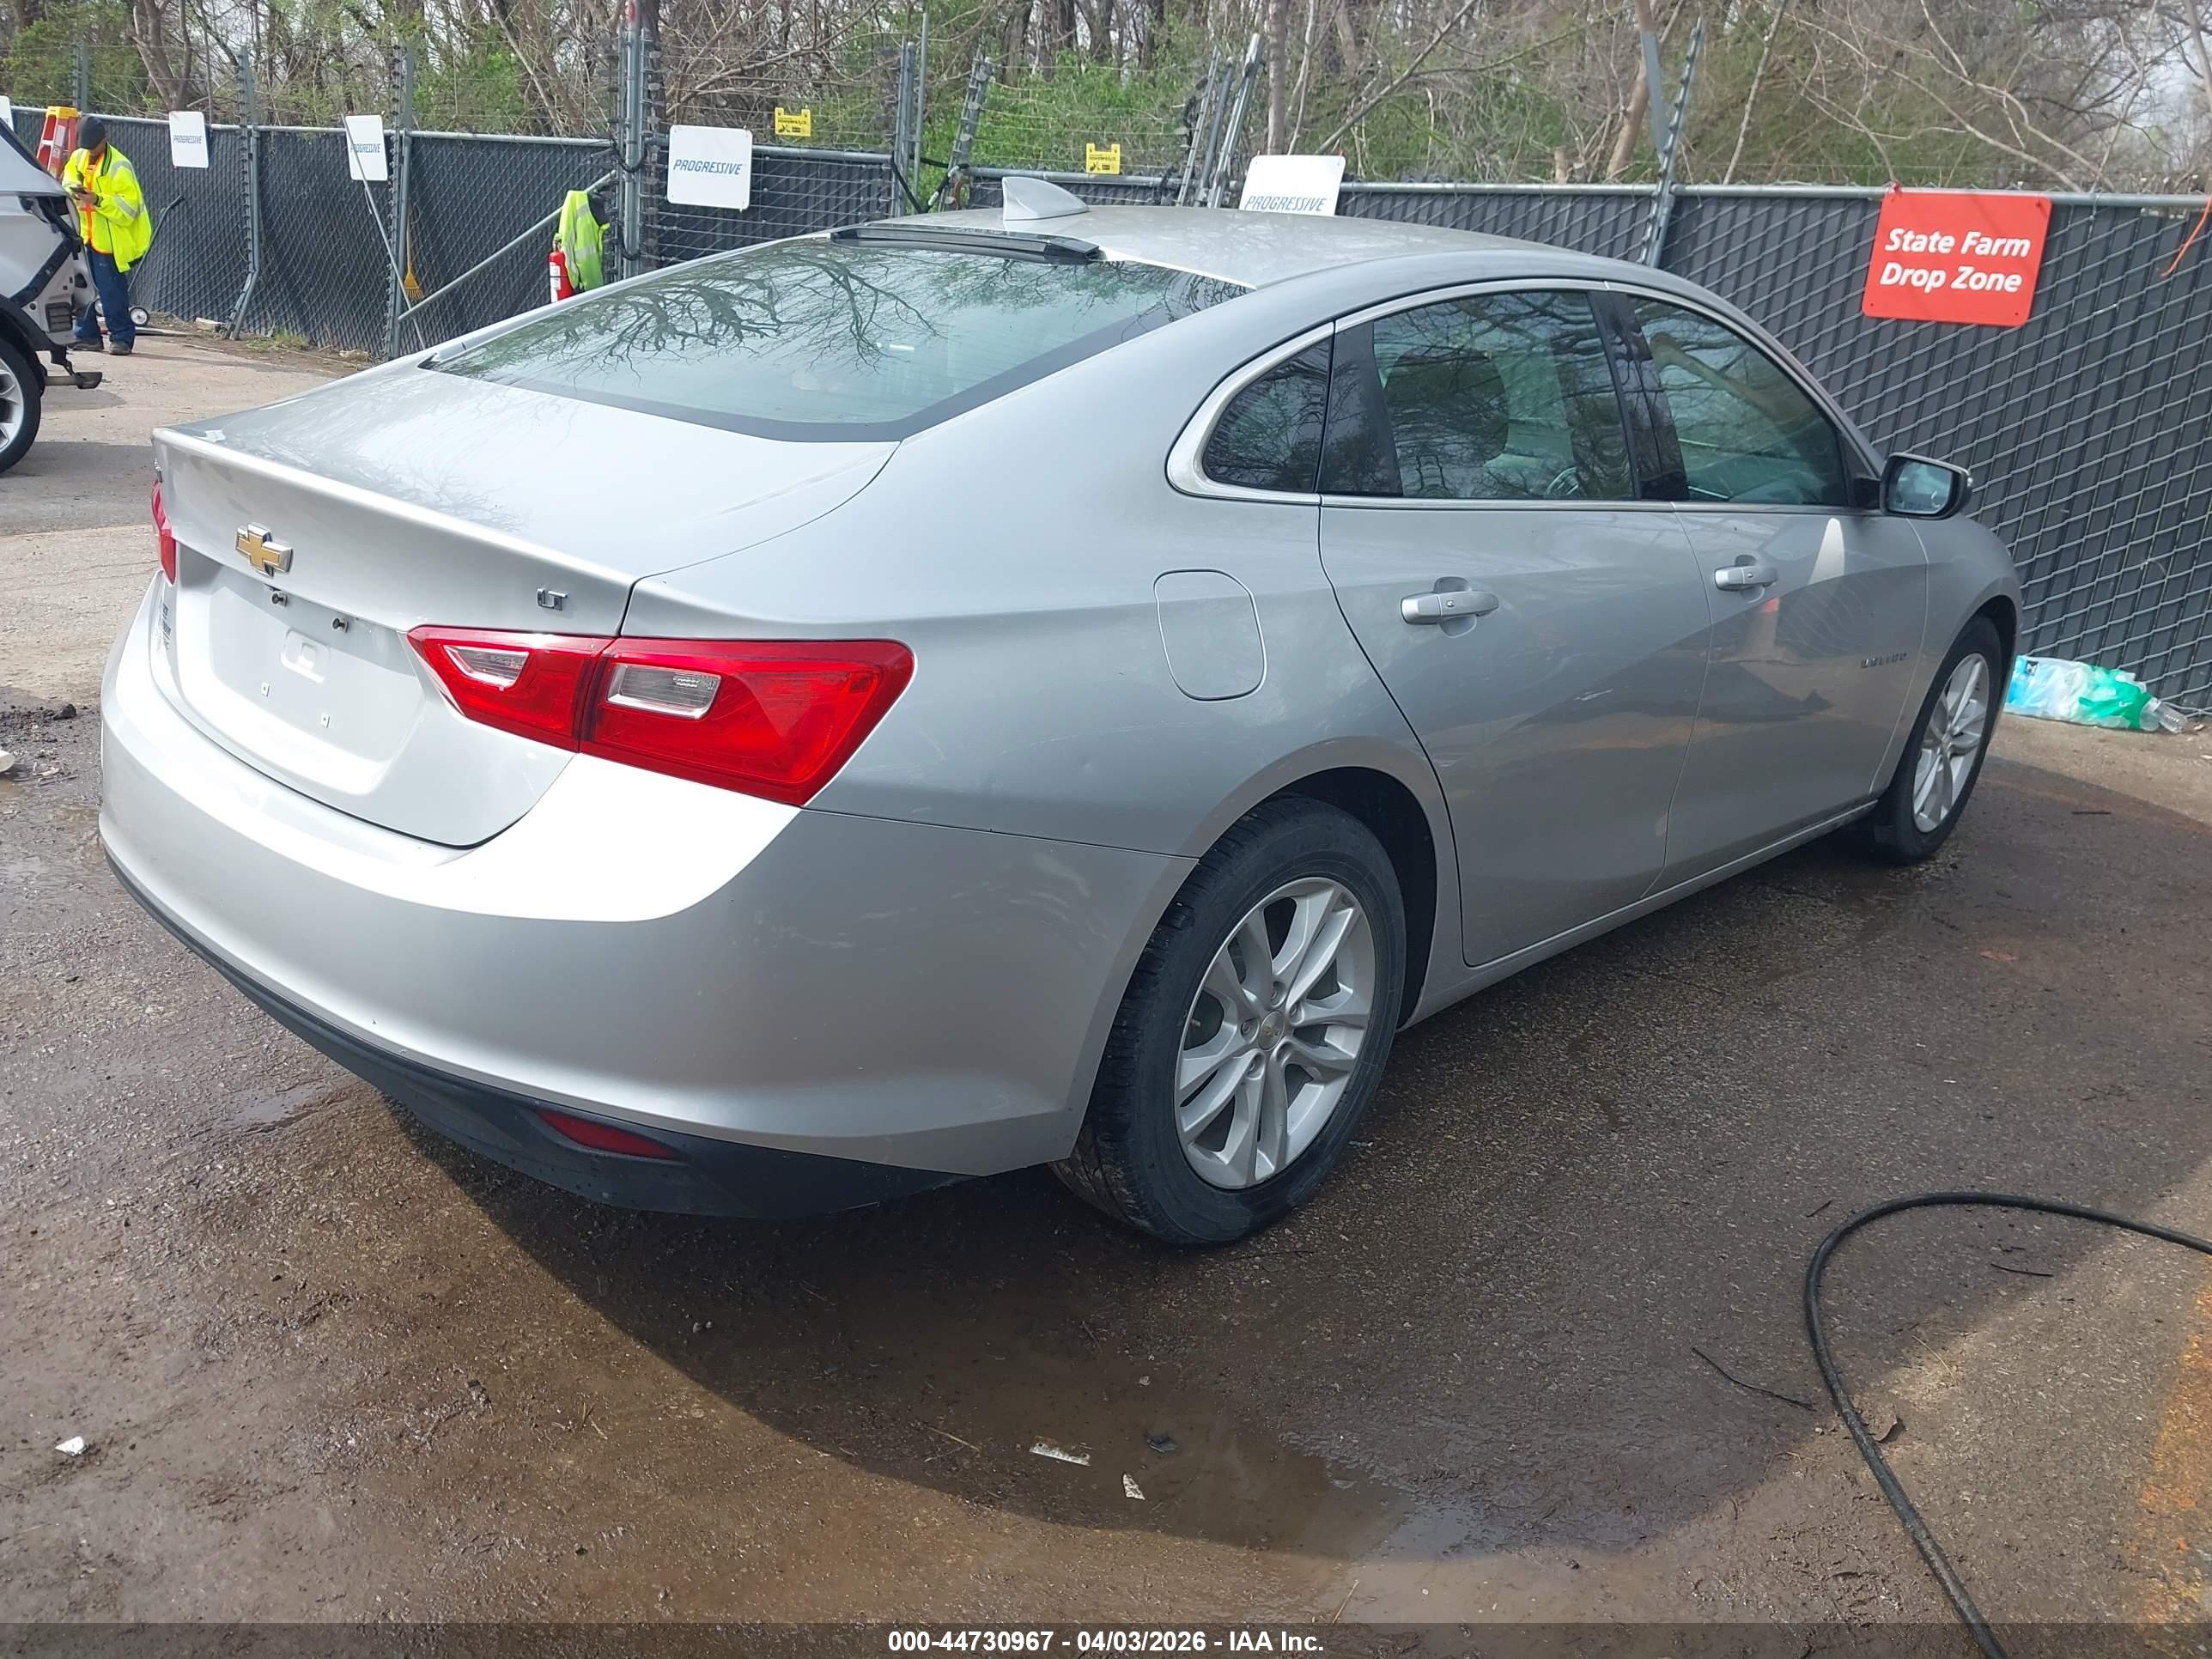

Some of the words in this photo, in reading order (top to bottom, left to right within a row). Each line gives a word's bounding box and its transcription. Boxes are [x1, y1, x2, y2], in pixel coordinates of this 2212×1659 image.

[673, 159, 743, 175] PROGRESSIVE
[1243, 195, 1327, 211] PROGRESSIVE
[1884, 228, 1955, 254] State
[1960, 231, 2031, 258] Farm
[1880, 262, 1947, 294] Drop
[1950, 265, 2022, 293] Zone
